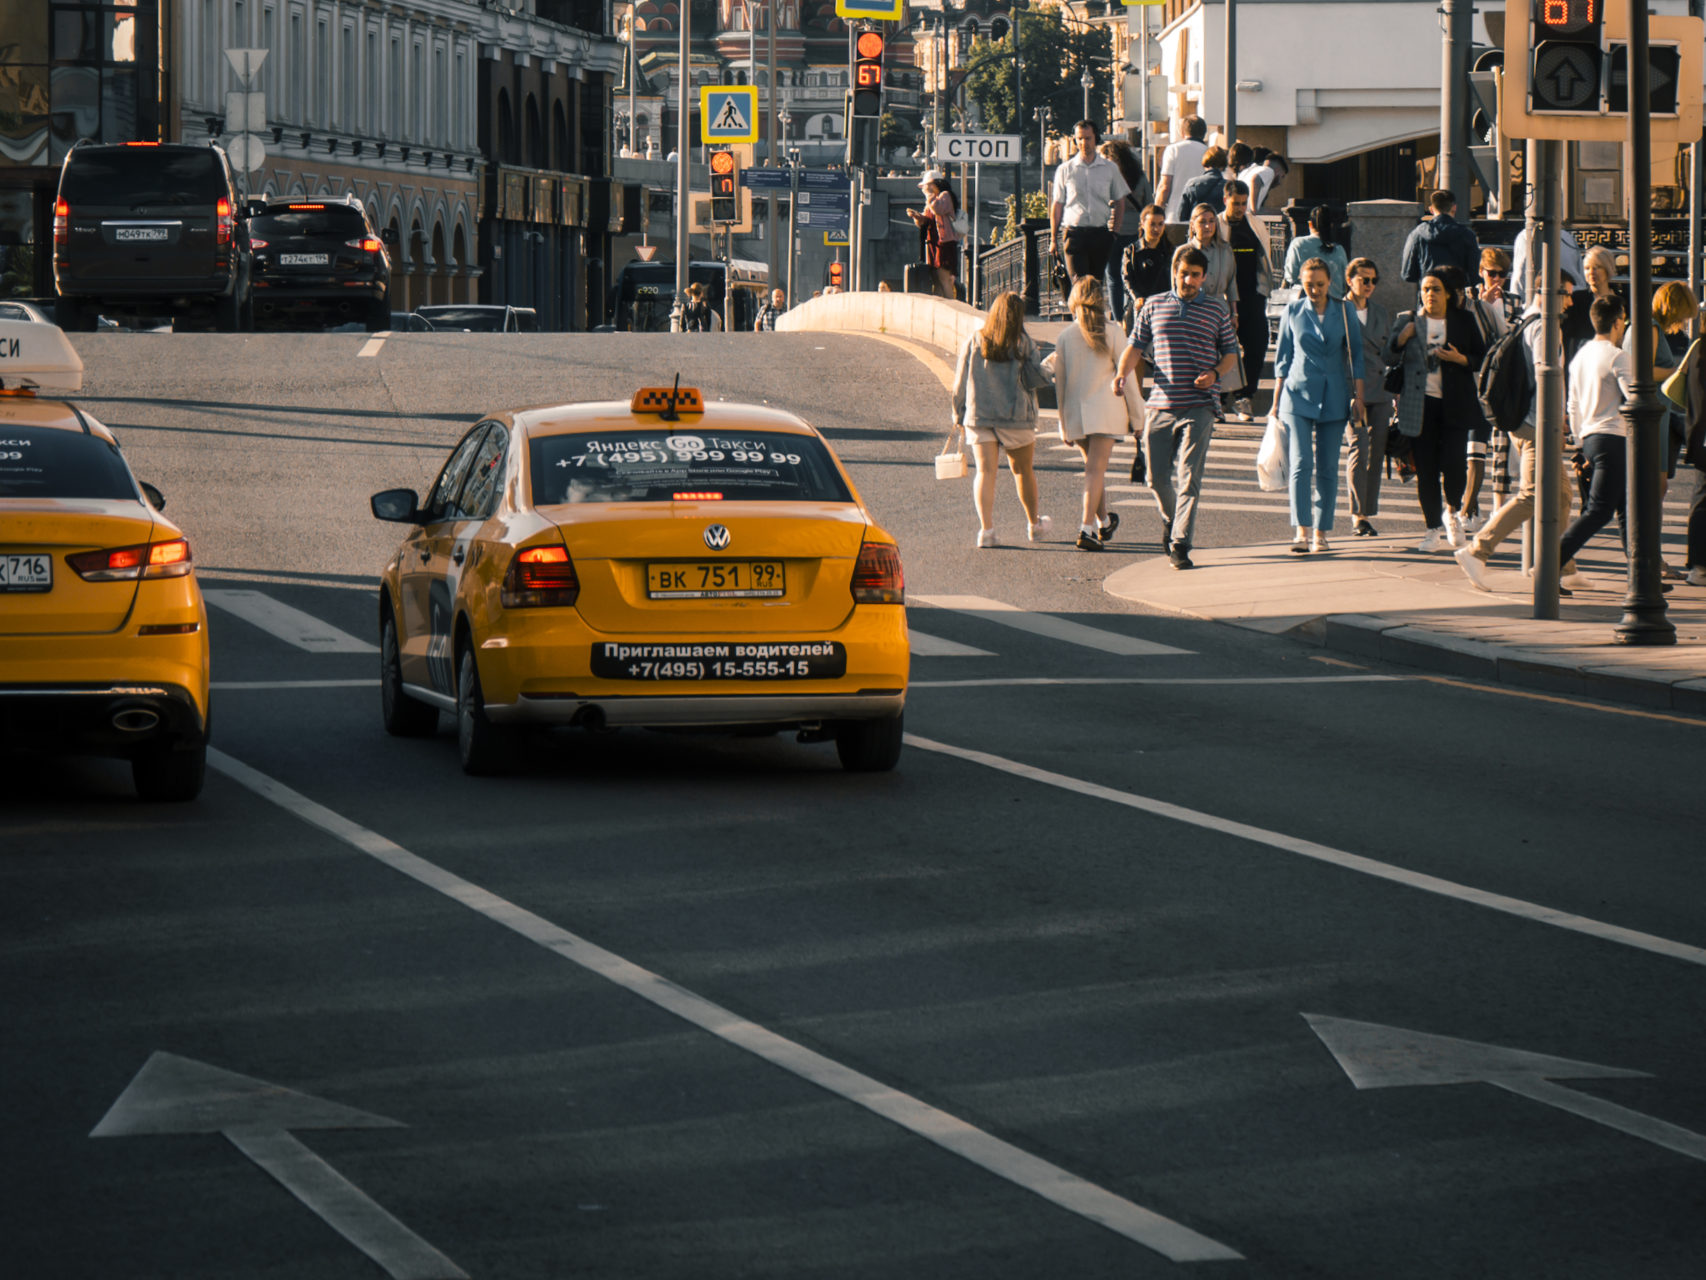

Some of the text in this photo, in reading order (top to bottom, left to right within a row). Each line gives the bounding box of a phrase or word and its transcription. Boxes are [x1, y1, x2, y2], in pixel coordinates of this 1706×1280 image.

[858, 65, 881, 85] 67
[949, 139, 1009, 157] СТОП
[586, 437, 767, 453] Яндекс Go Такси
[556, 450, 801, 468] +7 (495) 999 99 99
[10, 558, 47, 576] 716
[697, 566, 739, 587] 751
[753, 565, 775, 581] 99
[604, 641, 834, 660] Приглашаем водителей
[628, 661, 809, 680] +7(495) 15-555-15
